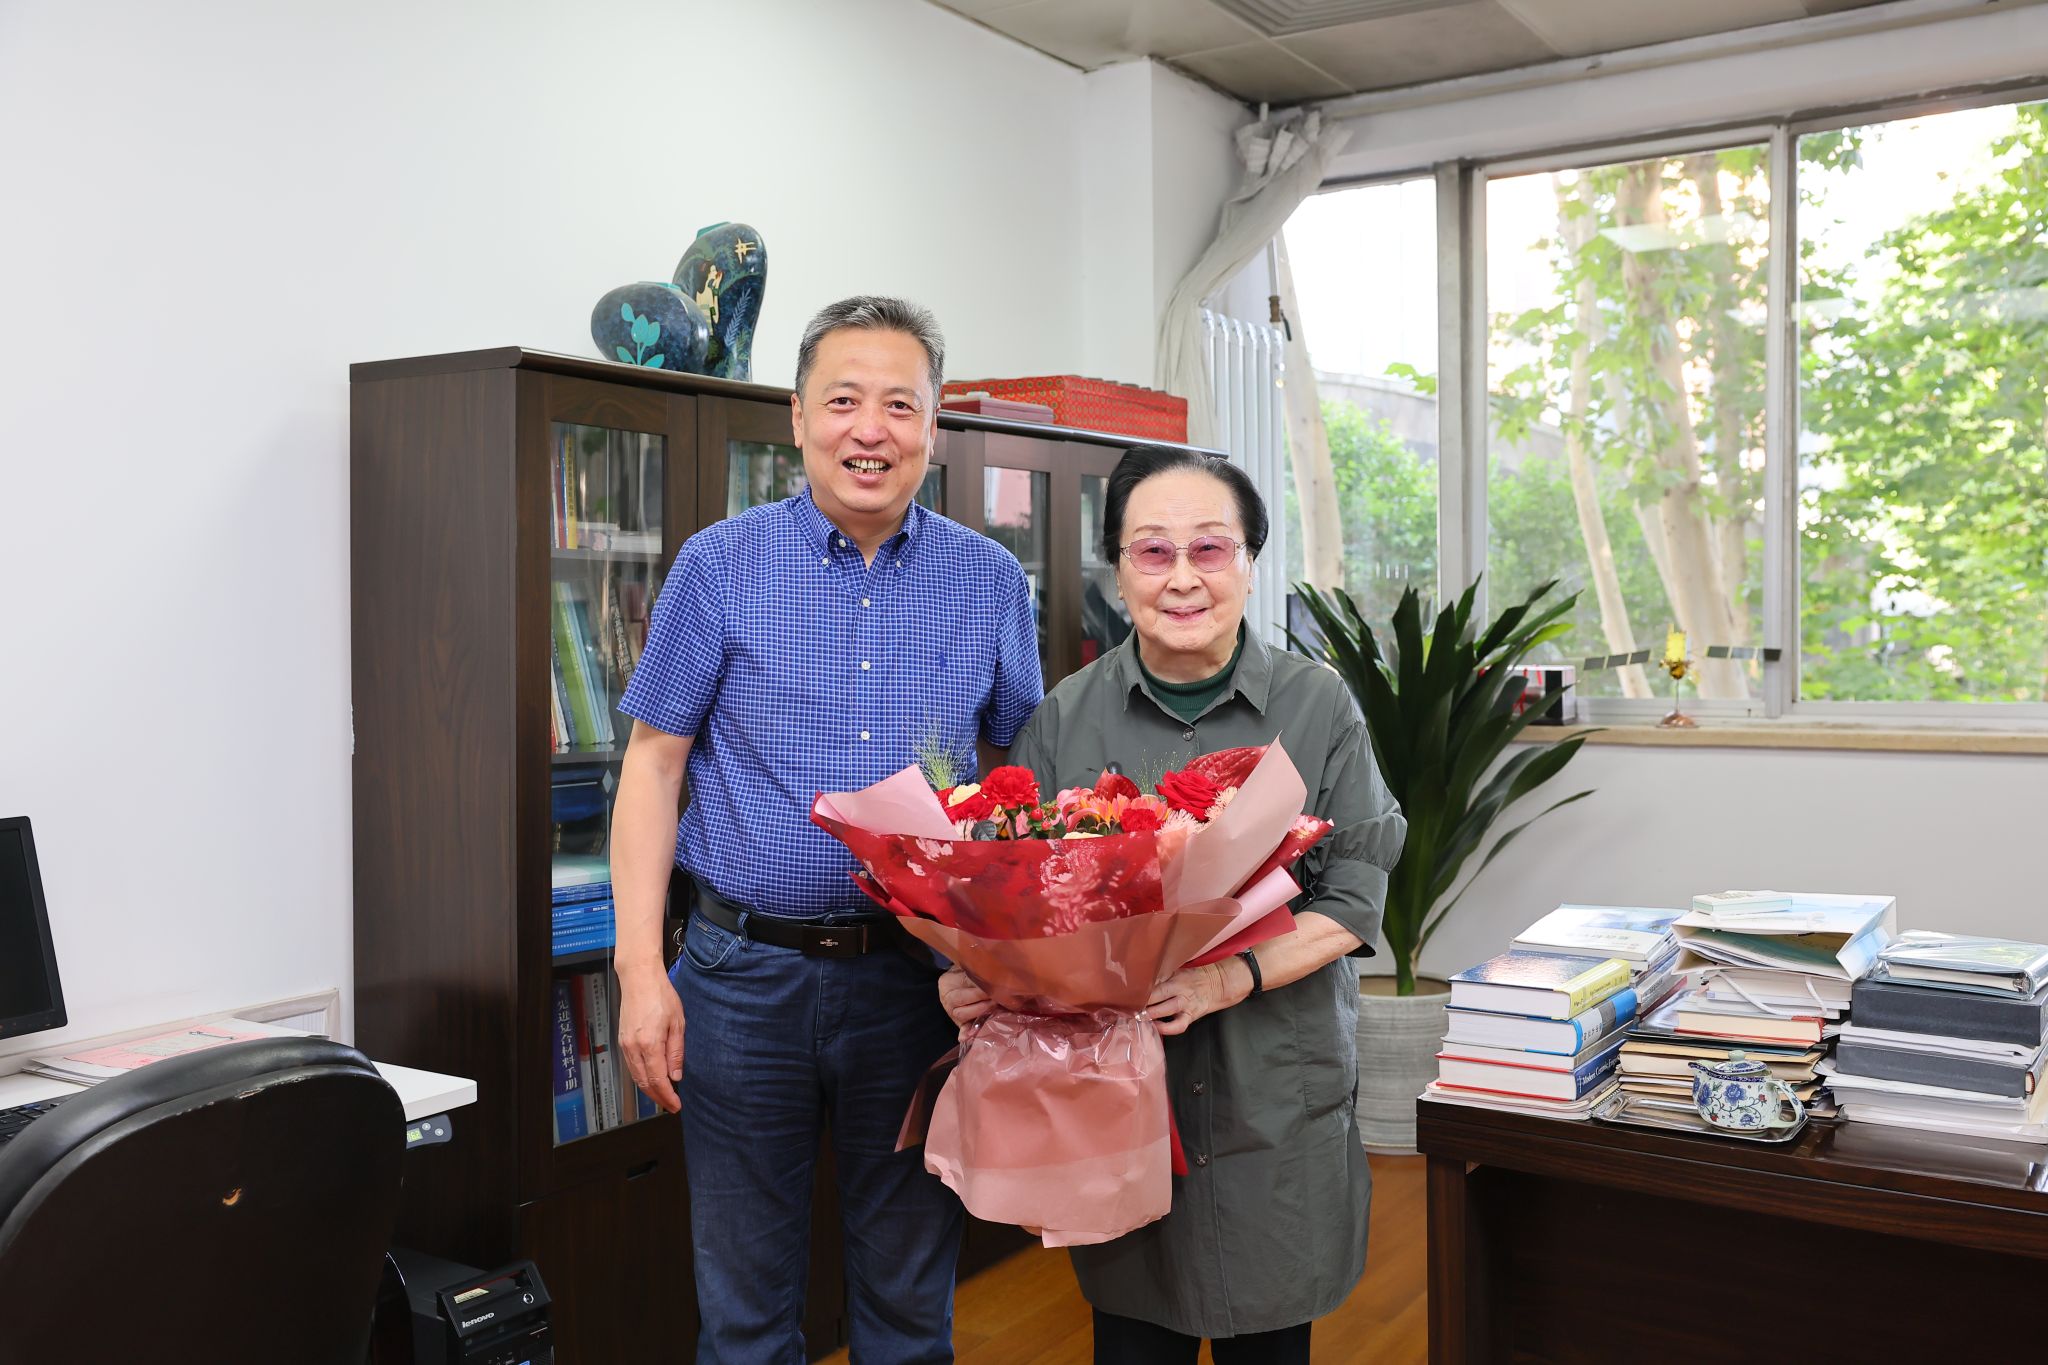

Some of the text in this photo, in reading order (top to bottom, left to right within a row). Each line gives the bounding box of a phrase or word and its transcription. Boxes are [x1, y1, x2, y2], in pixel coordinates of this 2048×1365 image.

[557, 999, 578, 1091] 先进复合材料手册
[1582, 1072, 1596, 1086] Modern
[462, 1312, 495, 1328] lenovo
